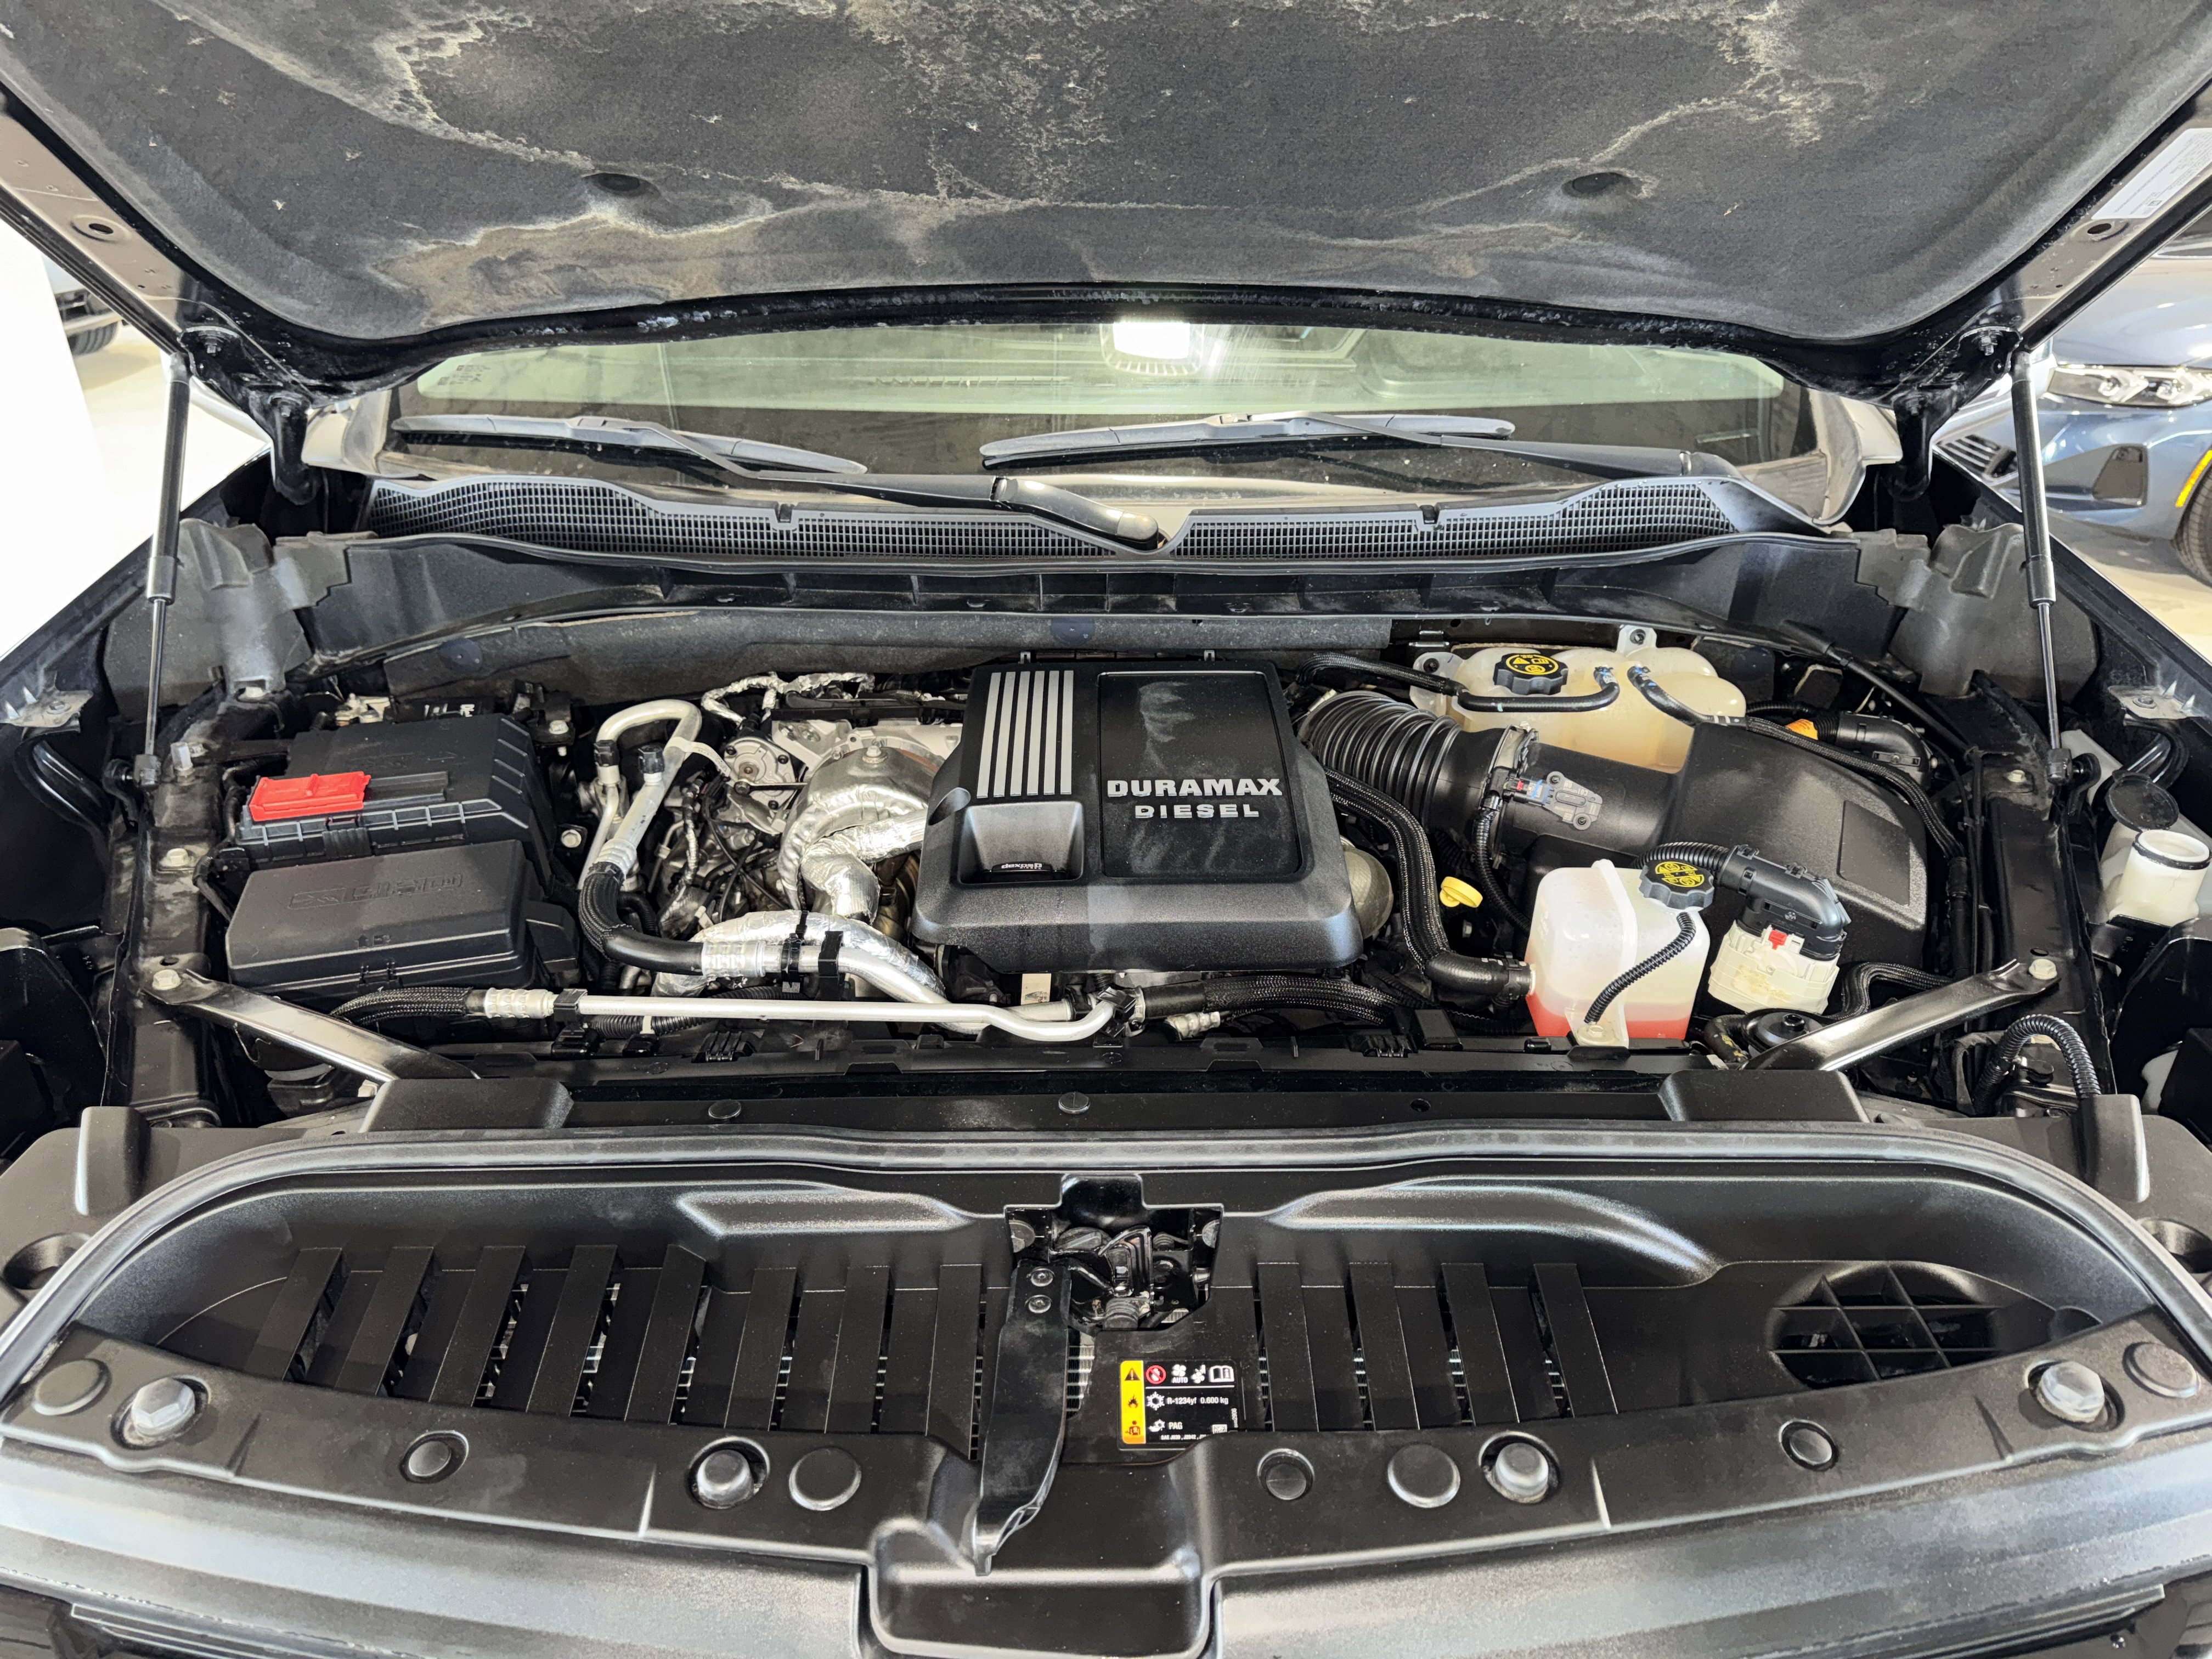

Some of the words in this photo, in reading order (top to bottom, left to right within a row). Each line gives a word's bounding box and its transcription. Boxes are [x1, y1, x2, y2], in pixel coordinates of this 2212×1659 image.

[1107, 778, 1283, 797] DURAMAX
[1135, 804, 1259, 819] DIESEL
[1167, 1397, 1197, 1406] R-1234yf
